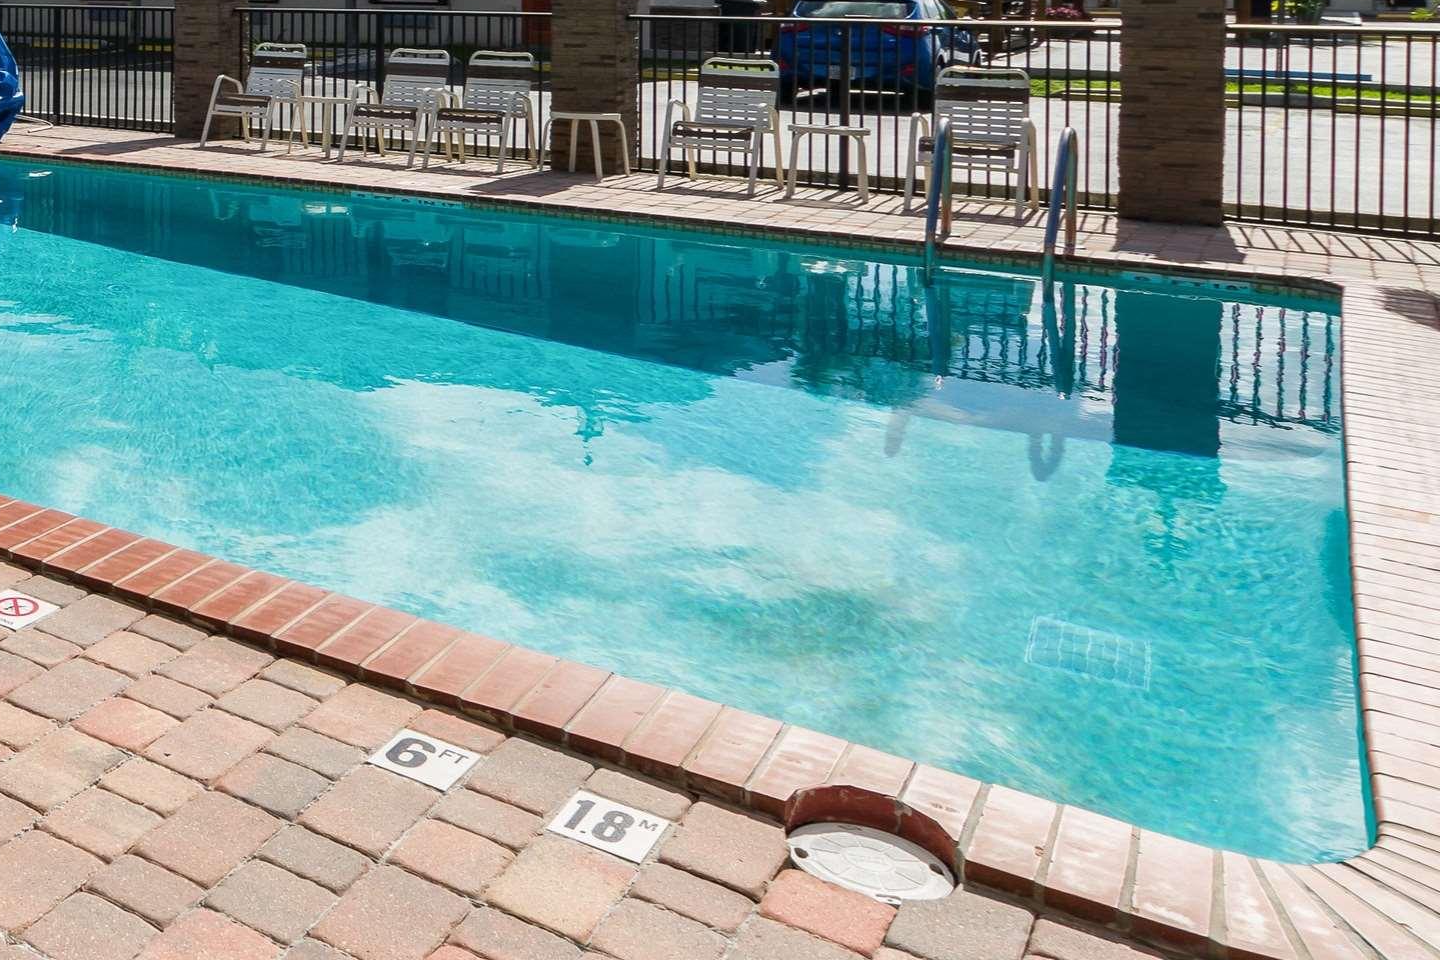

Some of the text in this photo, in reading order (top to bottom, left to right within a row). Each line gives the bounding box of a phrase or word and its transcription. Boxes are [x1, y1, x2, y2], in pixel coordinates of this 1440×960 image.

[385, 737, 469, 769] 6 FT
[563, 798, 659, 844] 1.8 M
